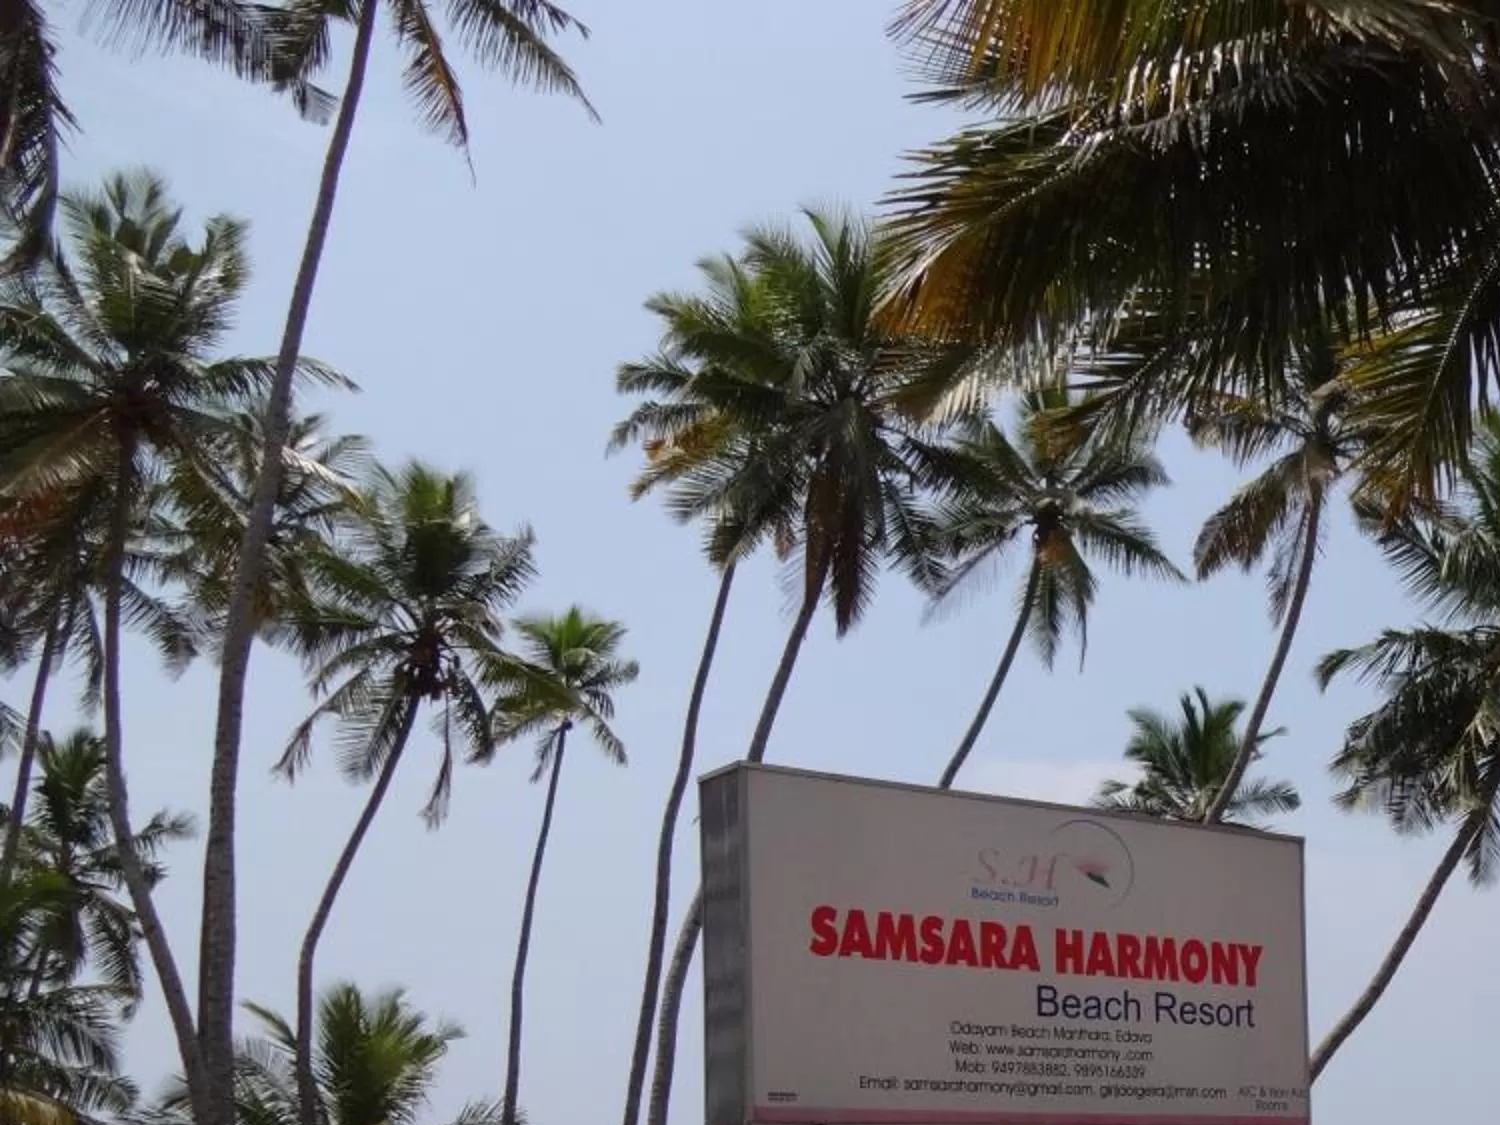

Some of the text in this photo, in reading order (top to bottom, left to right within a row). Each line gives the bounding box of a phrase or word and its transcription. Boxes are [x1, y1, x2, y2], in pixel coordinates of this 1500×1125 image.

[971, 887, 1059, 906] Beach Resort
[809, 906, 1263, 987] SAMSARA HARMONY
[1036, 985, 1256, 1028] Beach Resort
[950, 1021, 1008, 1038] Odayam
[1011, 1024, 1051, 1039] Beach
[1115, 1029, 1153, 1044] Edava
